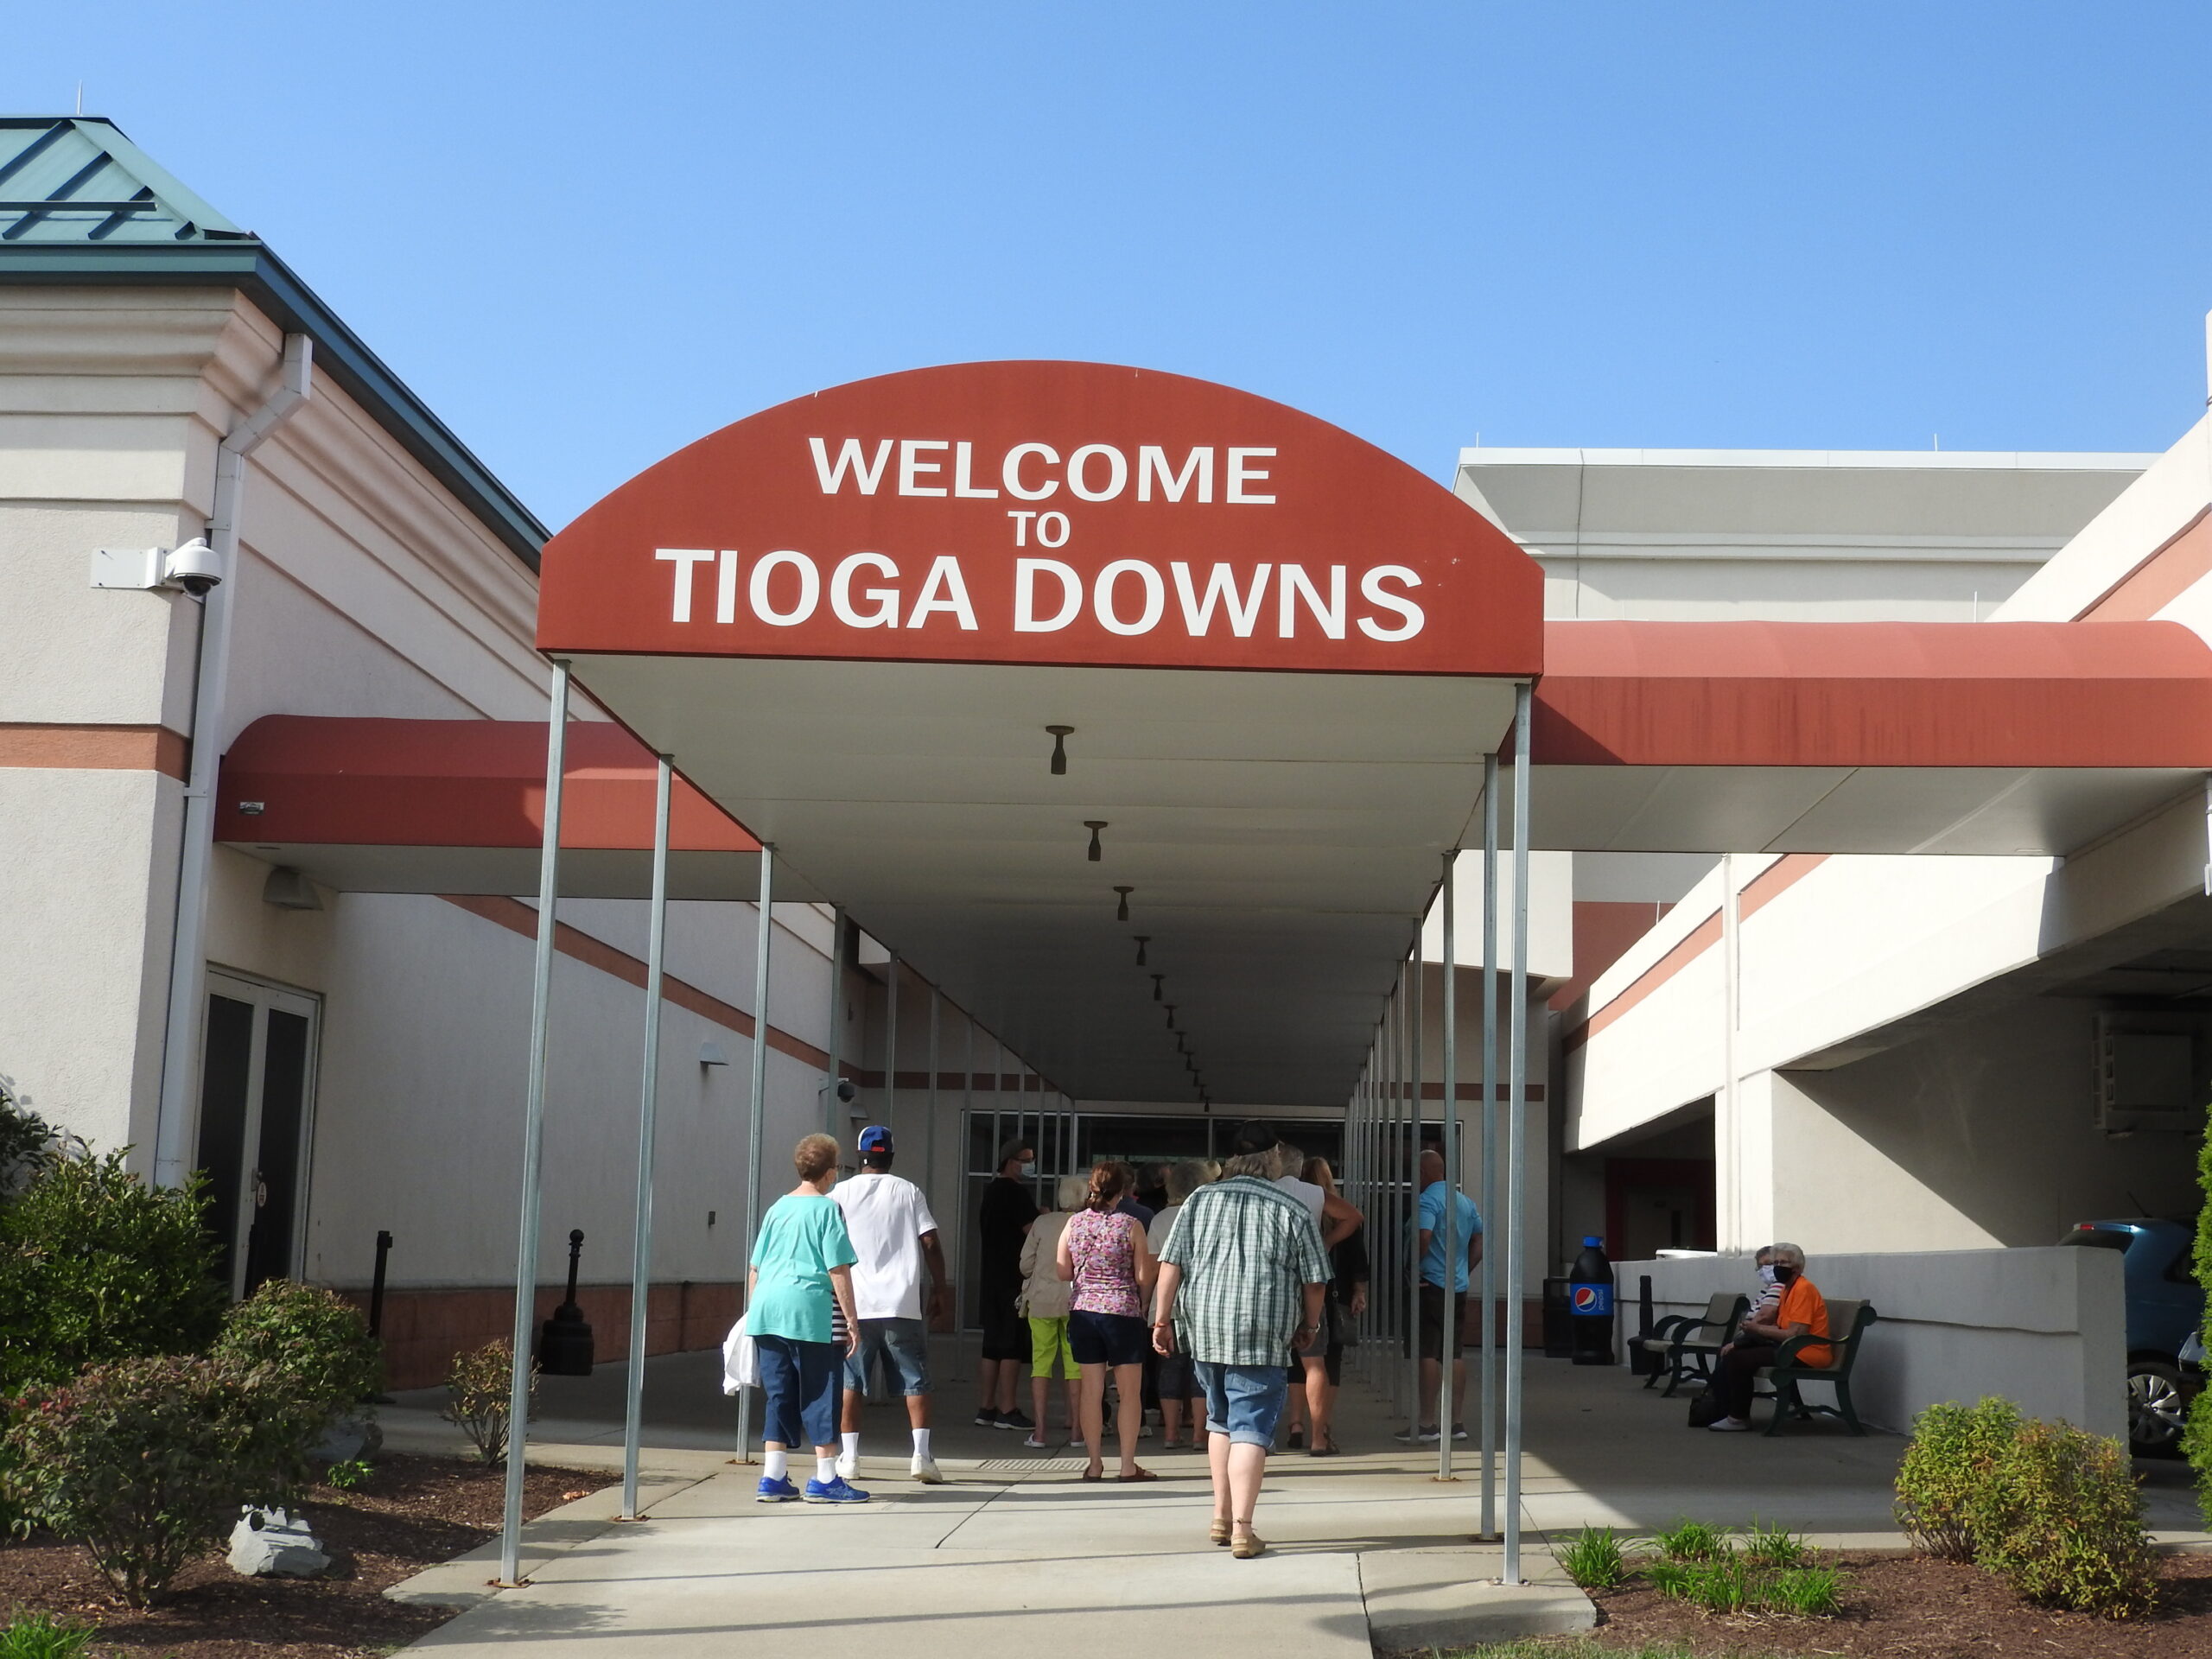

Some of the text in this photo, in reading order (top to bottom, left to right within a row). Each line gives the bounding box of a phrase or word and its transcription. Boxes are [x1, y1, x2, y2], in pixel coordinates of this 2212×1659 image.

[807, 437, 1278, 505] WELCOME
[1007, 510, 1071, 548] TO
[654, 548, 1426, 643] TIOGA DOWNS
